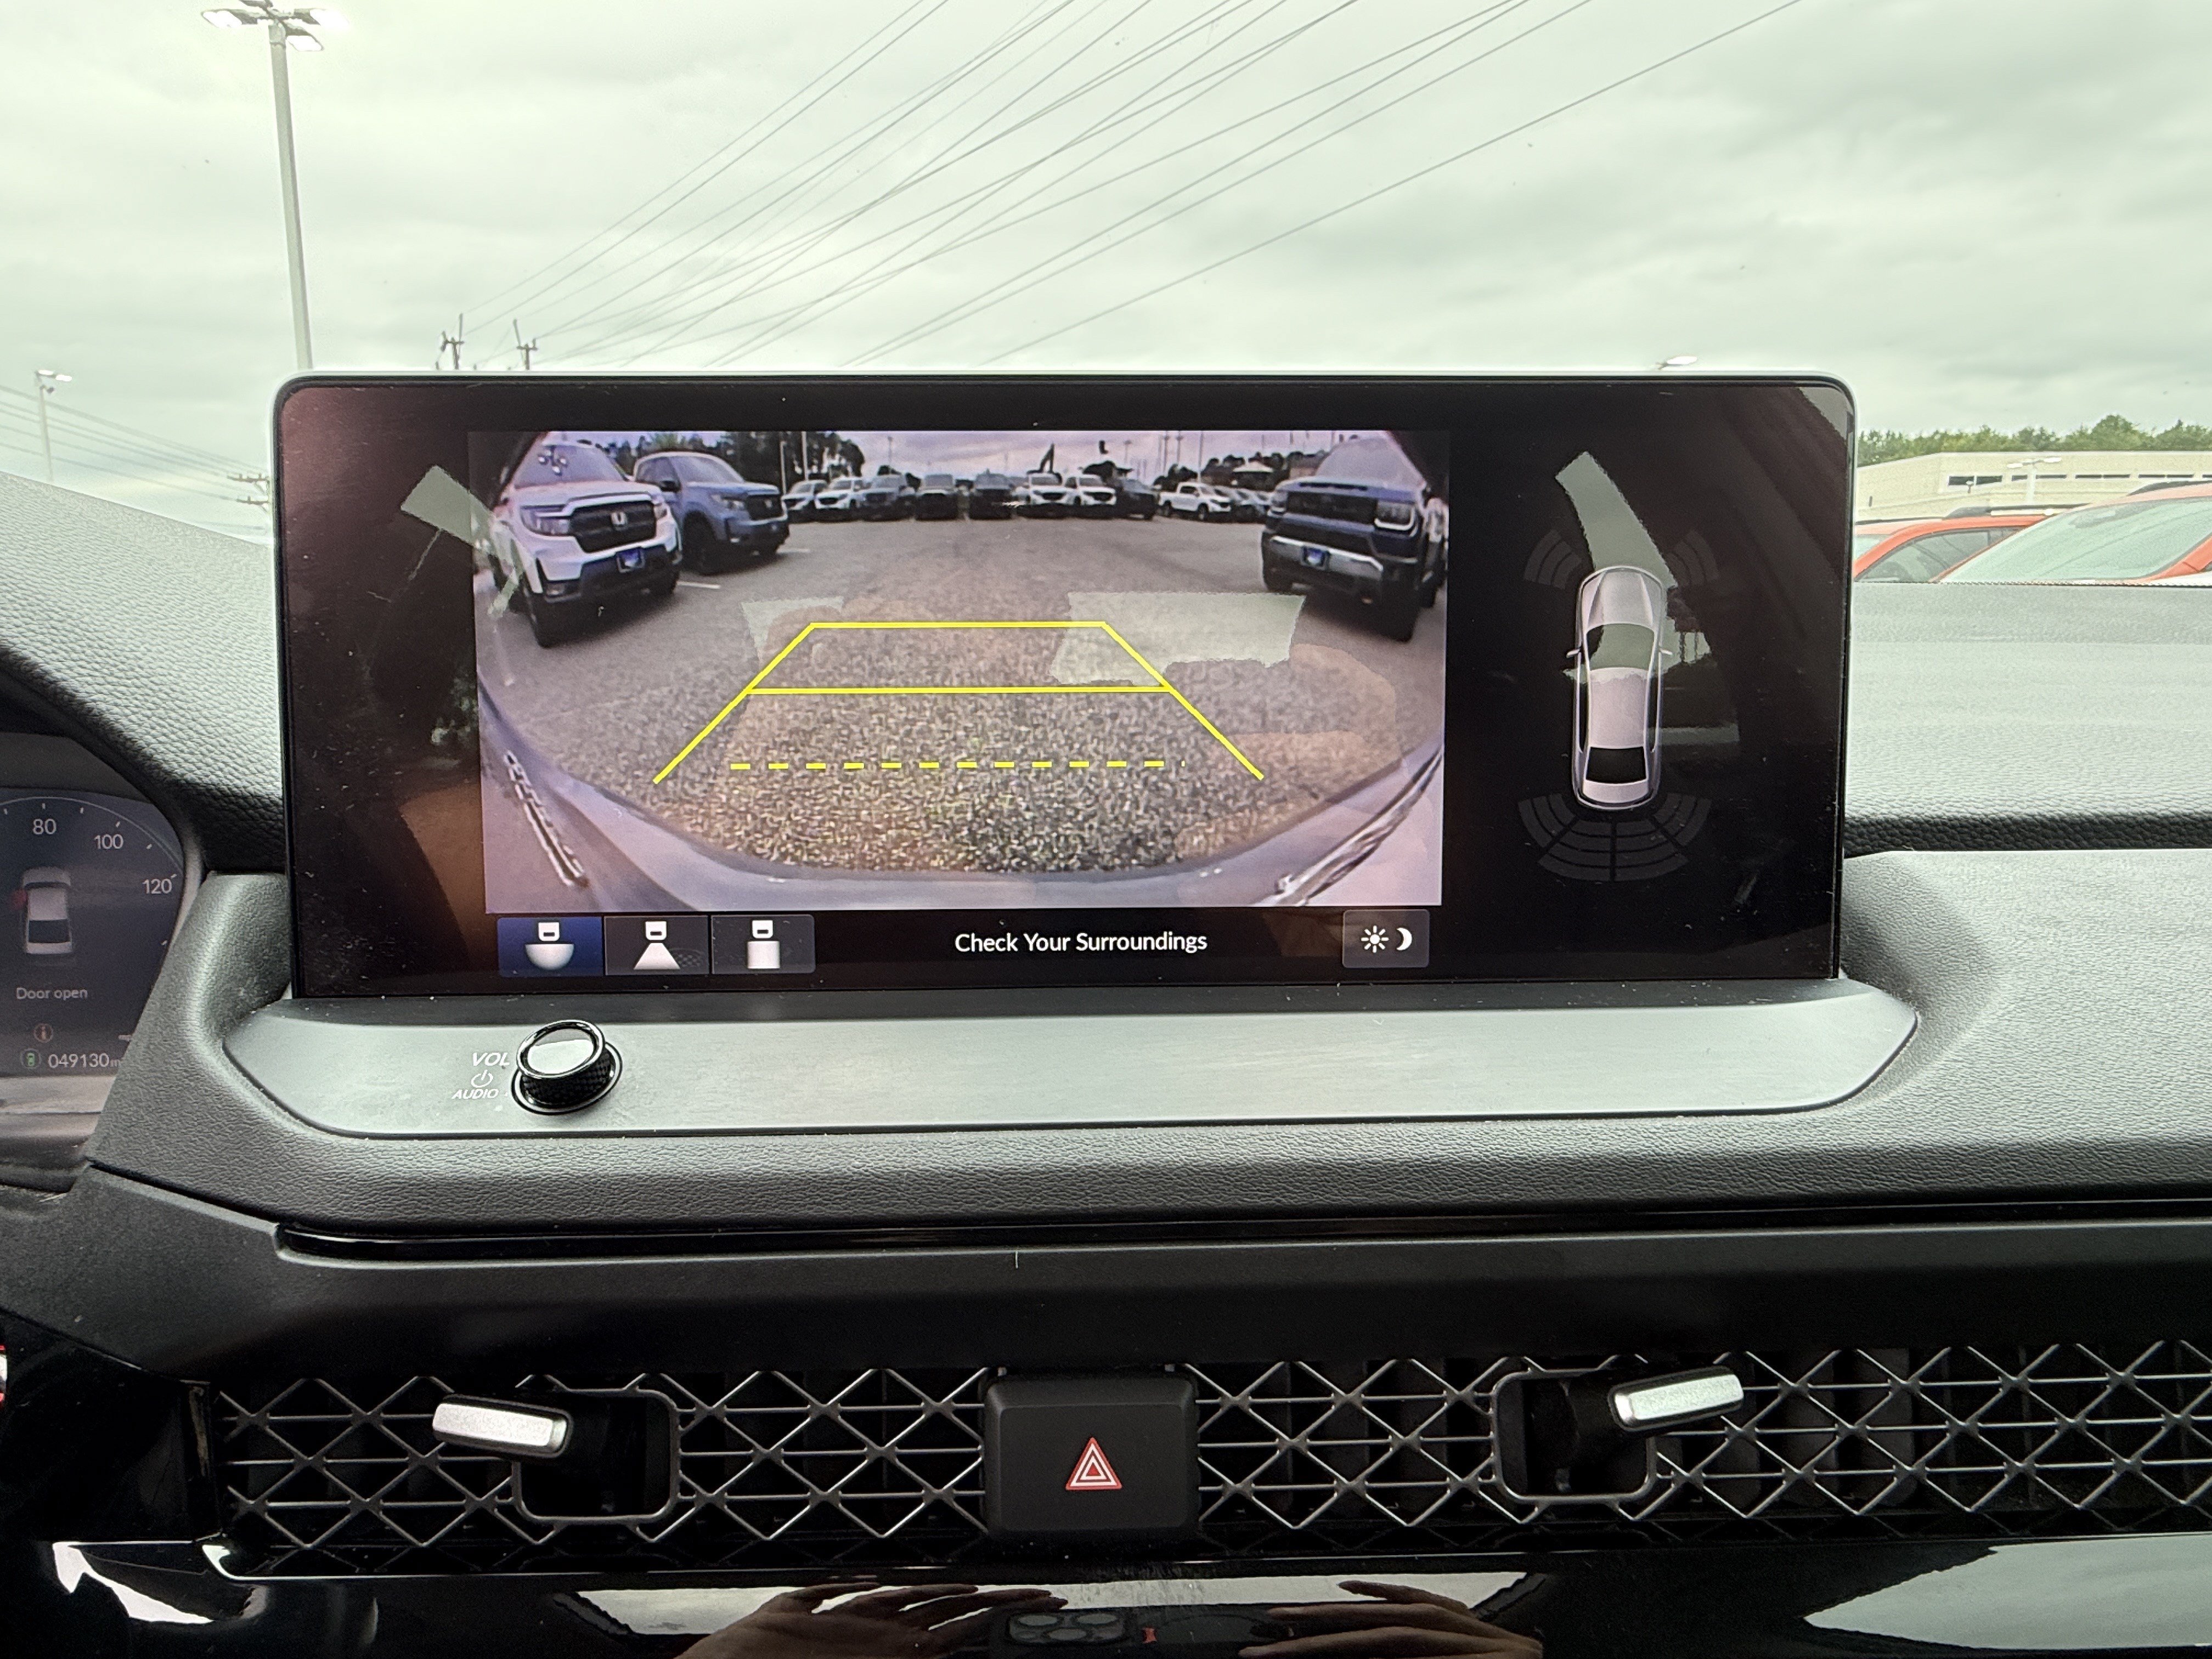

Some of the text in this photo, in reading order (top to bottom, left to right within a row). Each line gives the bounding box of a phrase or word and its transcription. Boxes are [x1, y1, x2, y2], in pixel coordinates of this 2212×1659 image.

[33, 819, 56, 834] 80
[94, 834, 123, 849] 100
[143, 879, 172, 894] 120
[955, 932, 1207, 953] Check Your Surroundings
[16, 988, 88, 1000] Door open
[472, 1052, 510, 1066] VOL
[452, 1088, 499, 1099] AUDIO
